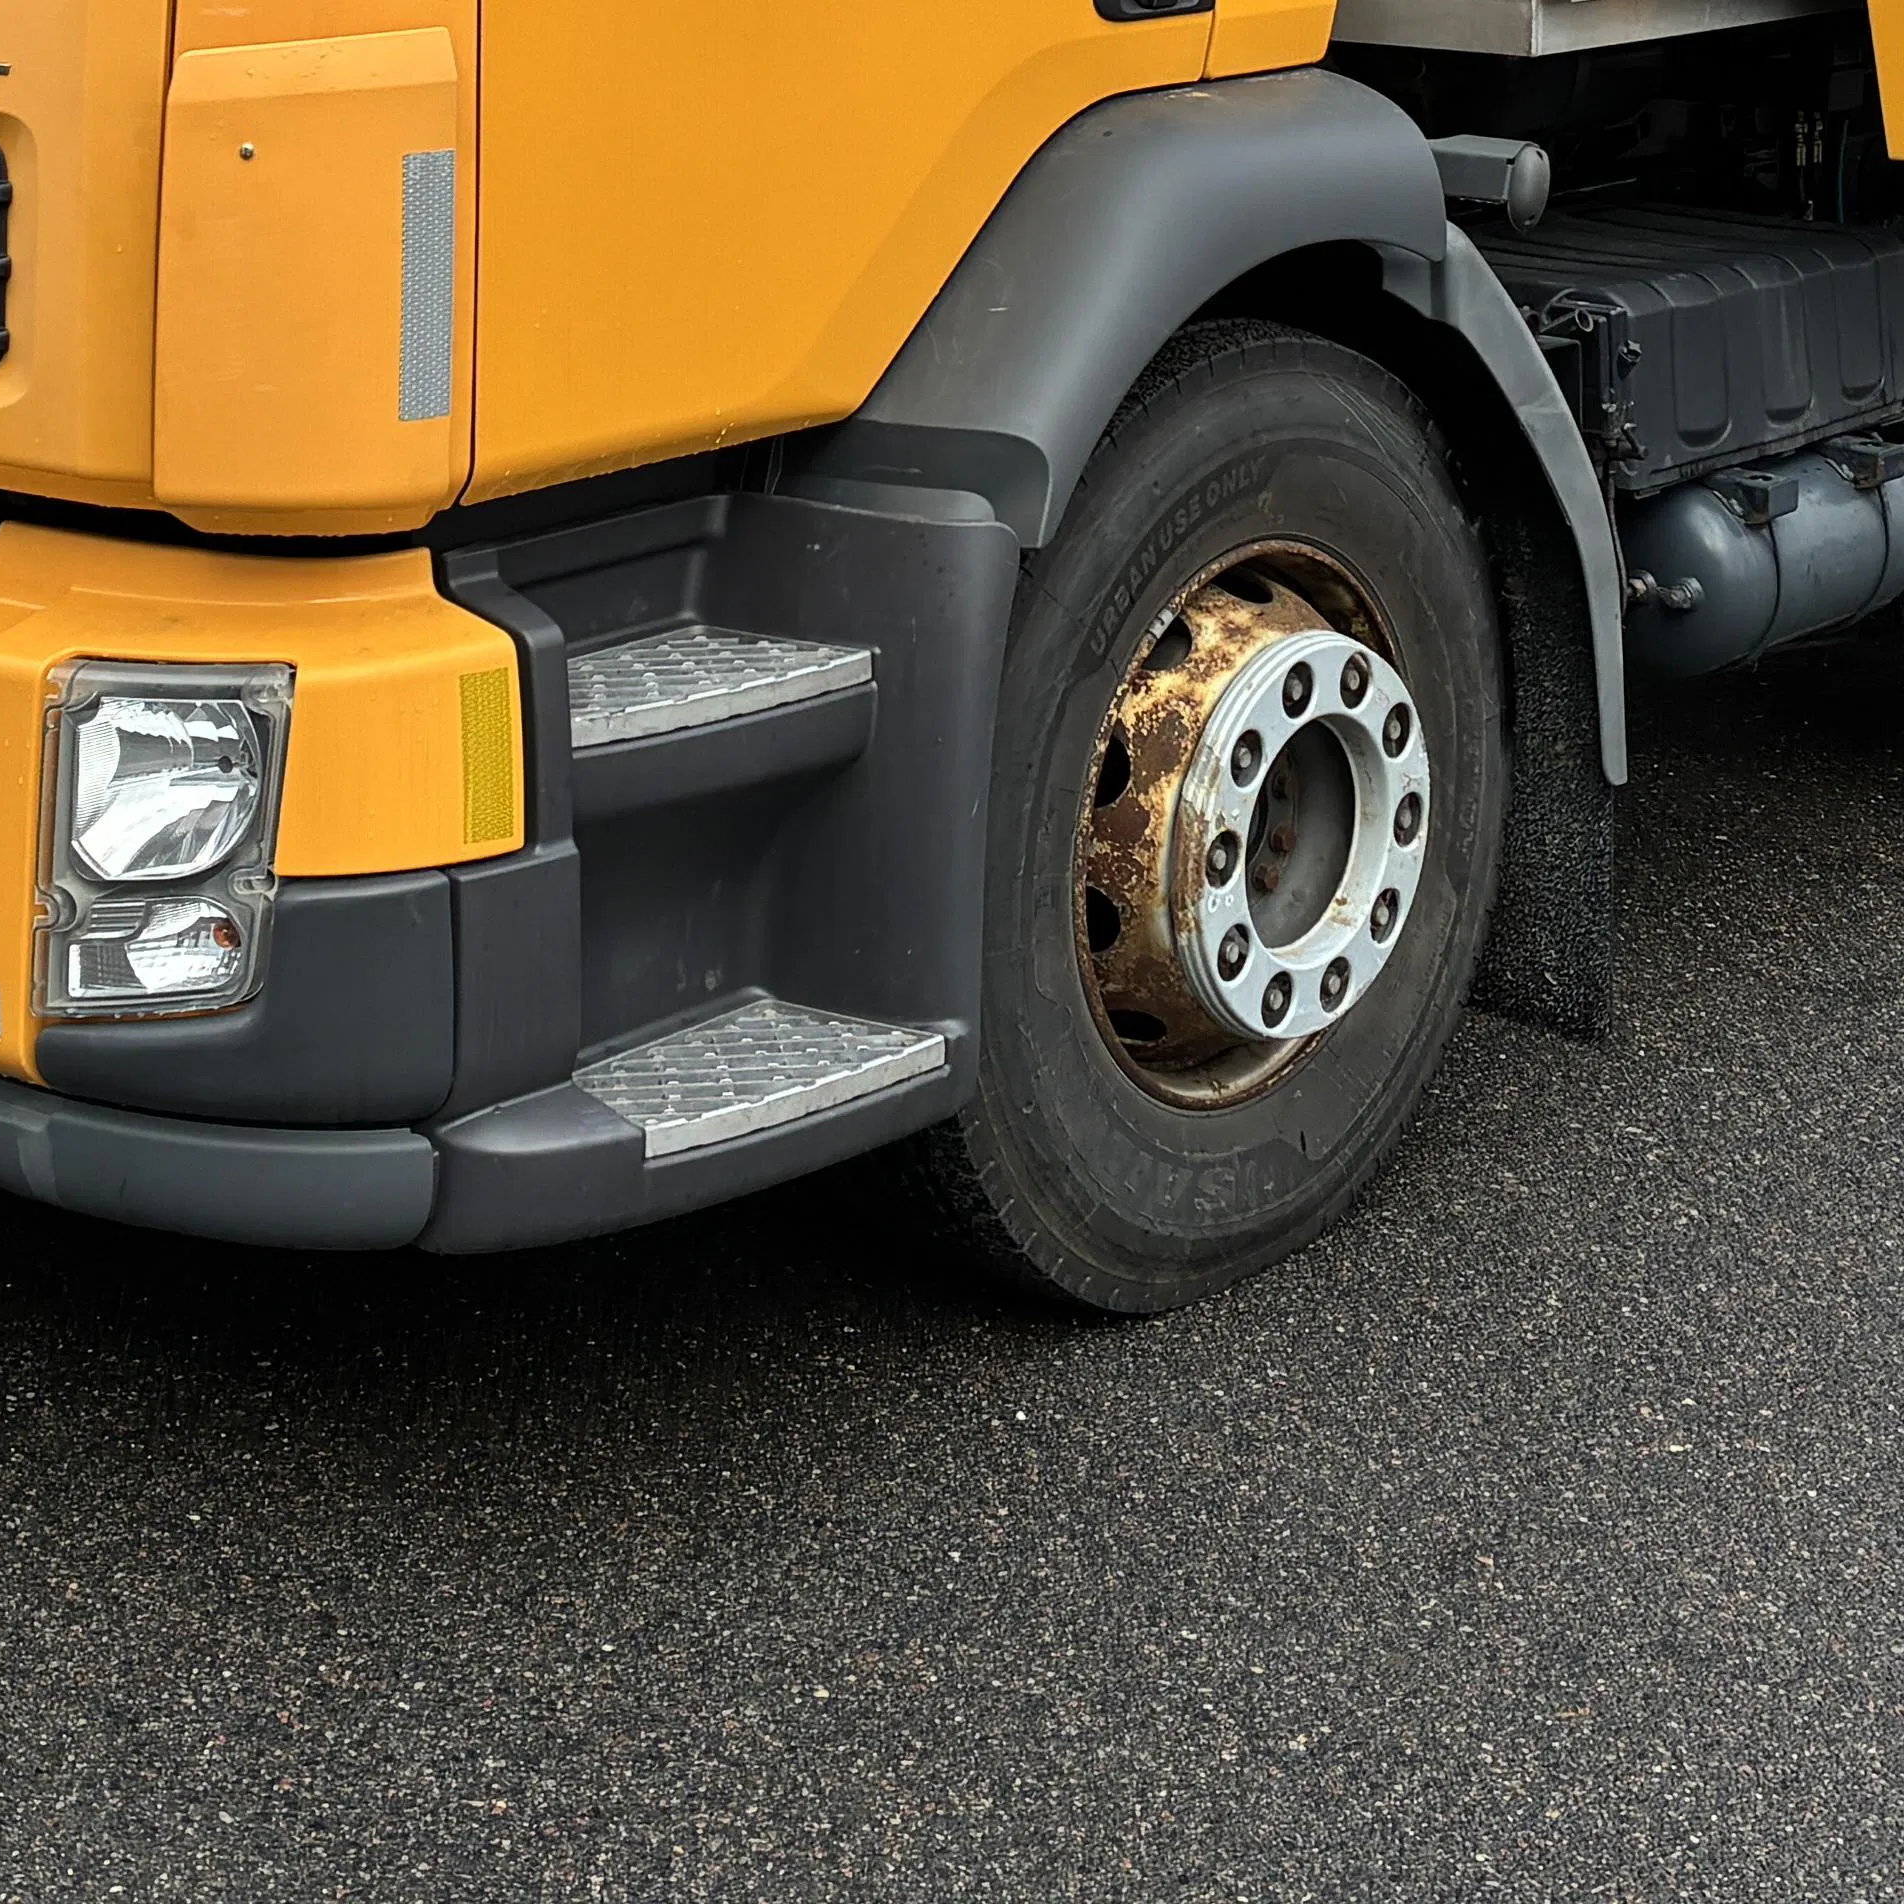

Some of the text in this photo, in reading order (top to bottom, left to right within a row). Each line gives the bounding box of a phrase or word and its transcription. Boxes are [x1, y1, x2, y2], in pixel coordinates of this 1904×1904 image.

[1090, 456, 1267, 656] URBAN USE ONLY
